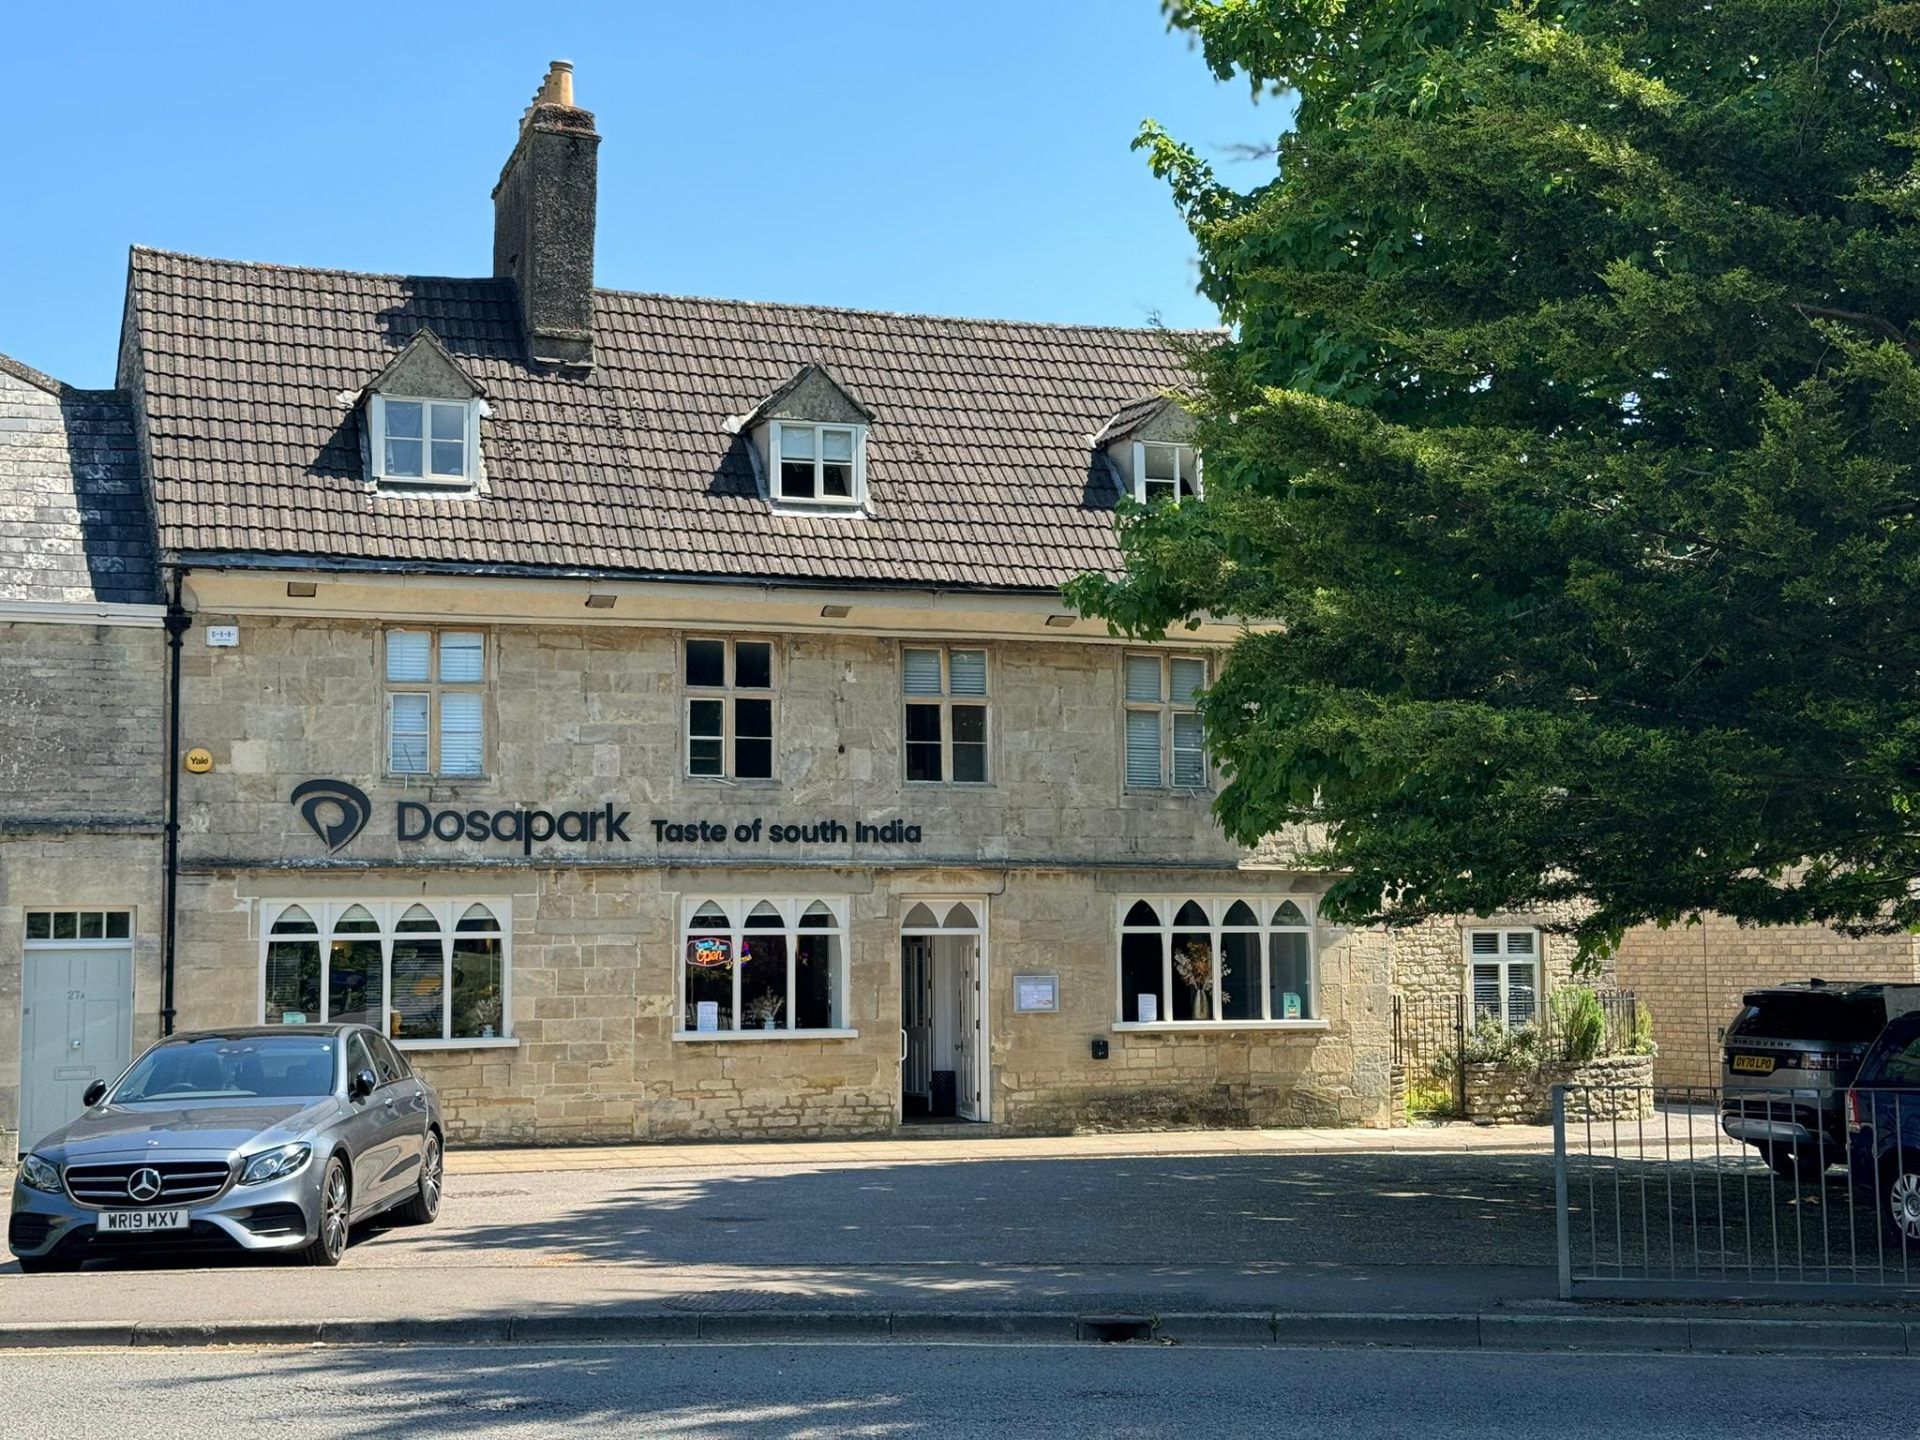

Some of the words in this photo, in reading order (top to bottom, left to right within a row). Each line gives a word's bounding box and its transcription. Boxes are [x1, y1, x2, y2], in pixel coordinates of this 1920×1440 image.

[190, 756, 209, 765] Yale
[397, 801, 632, 855] Dosapark
[651, 819, 728, 843] Taste
[734, 818, 762, 843] of
[768, 819, 848, 843] south
[855, 818, 922, 843] India
[696, 947, 725, 966] Open
[67, 990, 87, 1000] 27A
[108, 1213, 143, 1229] WR19
[147, 1211, 179, 1227] MXV
